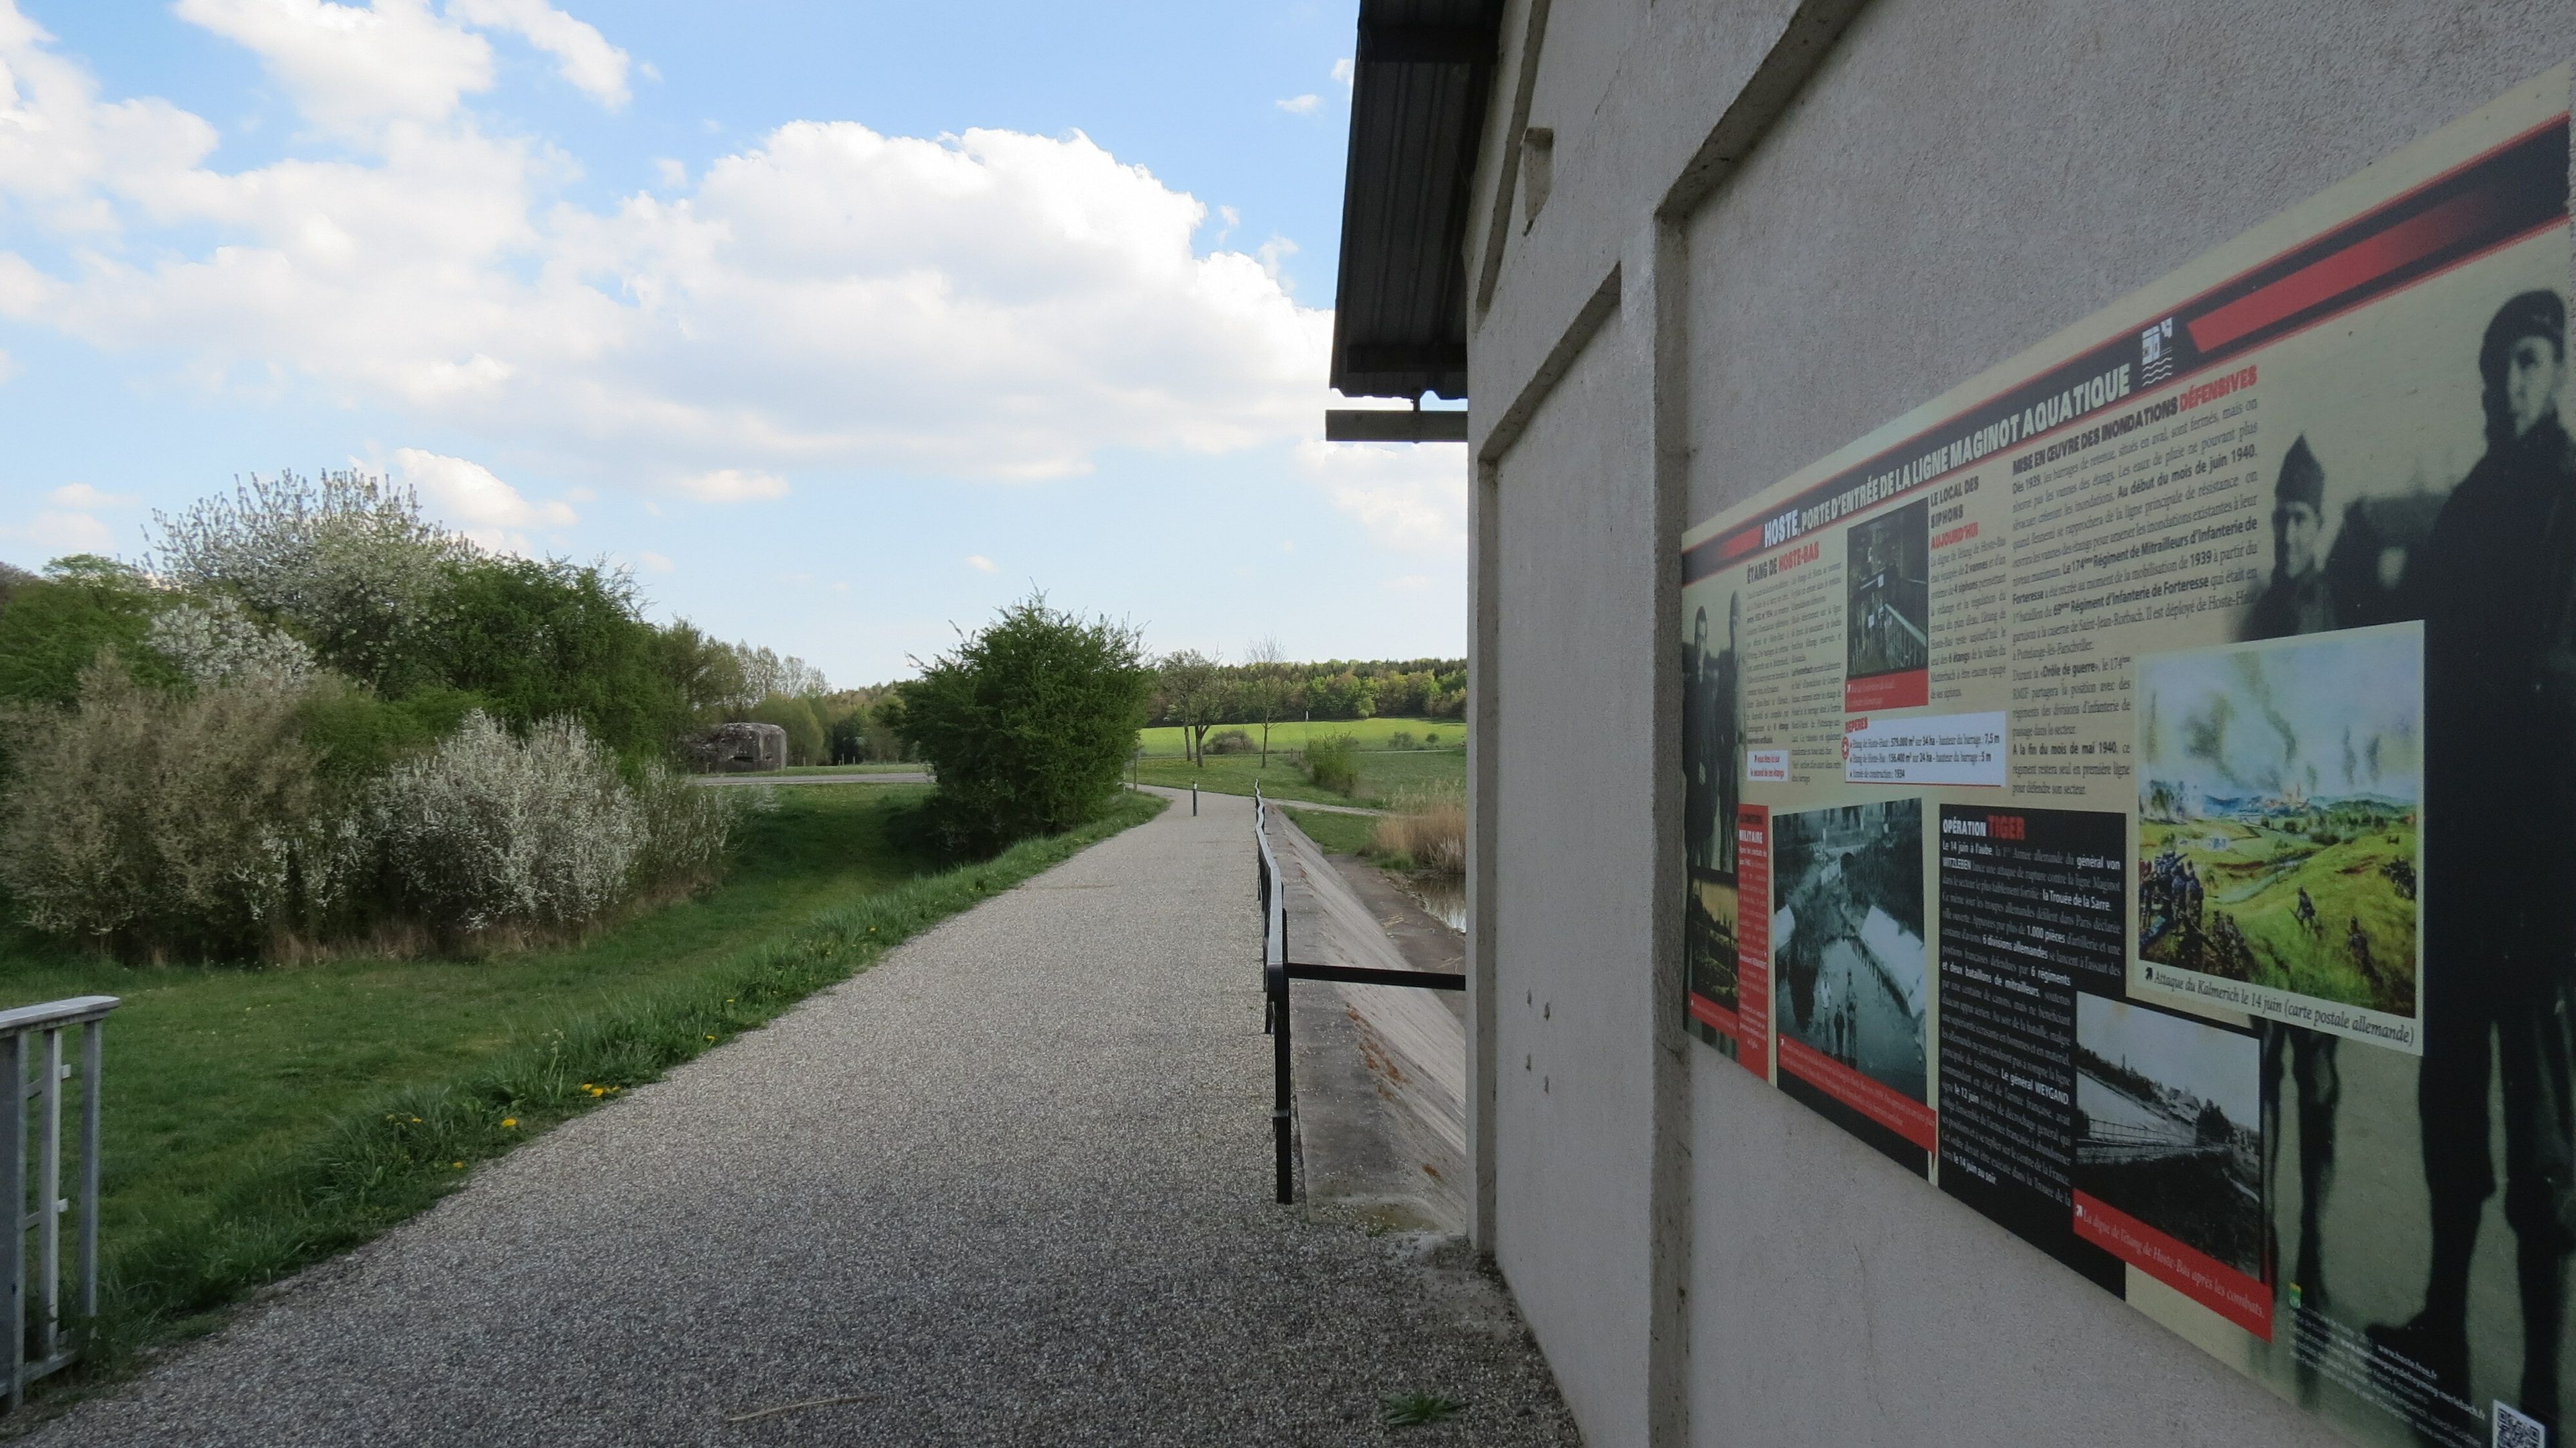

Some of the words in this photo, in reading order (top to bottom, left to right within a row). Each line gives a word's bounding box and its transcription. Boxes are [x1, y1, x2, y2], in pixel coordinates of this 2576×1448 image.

[2012, 454, 2032, 476] MISE
[2035, 448, 2045, 468] EN
[2046, 435, 2080, 464] ŒUVRE
[2081, 427, 2099, 450] DES
[2101, 397, 2177, 443] INONDATIONS
[2180, 360, 2257, 413] DÉFENSIVES
[2222, 399, 2242, 419] mais
[2246, 397, 2257, 411] on
[1765, 507, 1800, 549] HOSTE,
[1802, 500, 1829, 531] PORTE
[1833, 473, 1877, 519] D'ENTRÉE
[1880, 471, 1894, 499] DE
[1896, 463, 1911, 492] LA
[1913, 446, 1948, 485] LIGNE
[1950, 413, 2019, 469] MAGINOT
[2023, 362, 2129, 441] AQUATIQUE
[2153, 451, 2161, 466] de
[2202, 425, 2235, 454] pouvant
[2239, 418, 2257, 442] plus
[2117, 483, 2127, 498] Au
[2131, 474, 2154, 494] début
[2157, 470, 2167, 486] du
[2171, 463, 2191, 482] mois
[2195, 458, 2206, 474] de
[2210, 452, 2226, 474] juin
[2186, 484, 2194, 500] de
[2198, 472, 2239, 497] résistance
[2245, 470, 2257, 483] on
[1931, 490, 1937, 507] LE
[1939, 480, 1963, 504] LOCAL
[1964, 474, 1978, 495] DES
[1931, 503, 1963, 529] SIPHONS
[2063, 560, 2070, 574] Le
[2094, 546, 2128, 570] Régiment
[2130, 544, 2139, 558] de
[2141, 531, 2188, 555] Mitrailleurs
[2245, 514, 2257, 531] de
[1748, 560, 1767, 584] ÉTANG
[1769, 558, 1776, 576] DE
[1778, 540, 1819, 572] HOSTE-BAS
[2012, 586, 2043, 604] Forteresse
[2190, 549, 2211, 566] 1939
[2220, 541, 2243, 564] partir
[2246, 539, 2257, 555] du
[2071, 594, 2103, 615] Régiment
[2151, 583, 2161, 597] de
[2164, 574, 2208, 594] Forteresse
[2196, 597, 2206, 611] de
[2070, 742, 2078, 754] de
[1943, 815, 1986, 837] OPÉRATION
[1987, 815, 2025, 840] TIGER
[1942, 839, 1948, 850] Le
[1951, 841, 1956, 851] 14
[1959, 841, 1968, 855] juin
[2076, 854, 2103, 872] général
[2106, 860, 2120, 870] von
[2043, 889, 2048, 900] la
[2050, 890, 2071, 904] Trouée
[2073, 894, 2081, 907] de
[2083, 895, 2089, 908] la
[2091, 896, 2111, 911] Sarre.
[1982, 933, 1986, 943] 6
[2045, 927, 2065, 945] pièces
[1942, 958, 1947, 970] et
[1994, 973, 2002, 986] de
[2031, 965, 2035, 977] 6
[2038, 967, 2071, 990] régiments
[2154, 970, 2182, 993] Attaque
[2186, 976, 2194, 993] du
[2198, 979, 2238, 1003] Kalmerich
[2241, 989, 2247, 1006] le
[2252, 992, 2261, 1009] 14
[2264, 994, 2280, 1017] juin
[2285, 998, 2311, 1025] (carte
[2315, 1005, 2349, 1034] postale
[2352, 1014, 2414, 1049] allemande)
[1954, 1083, 1960, 1095] le
[1961, 1086, 1967, 1098] 12
[2001, 1067, 2008, 1080] Le
[2010, 1071, 2032, 1093] général
[1953, 1151, 1958, 1163] le
